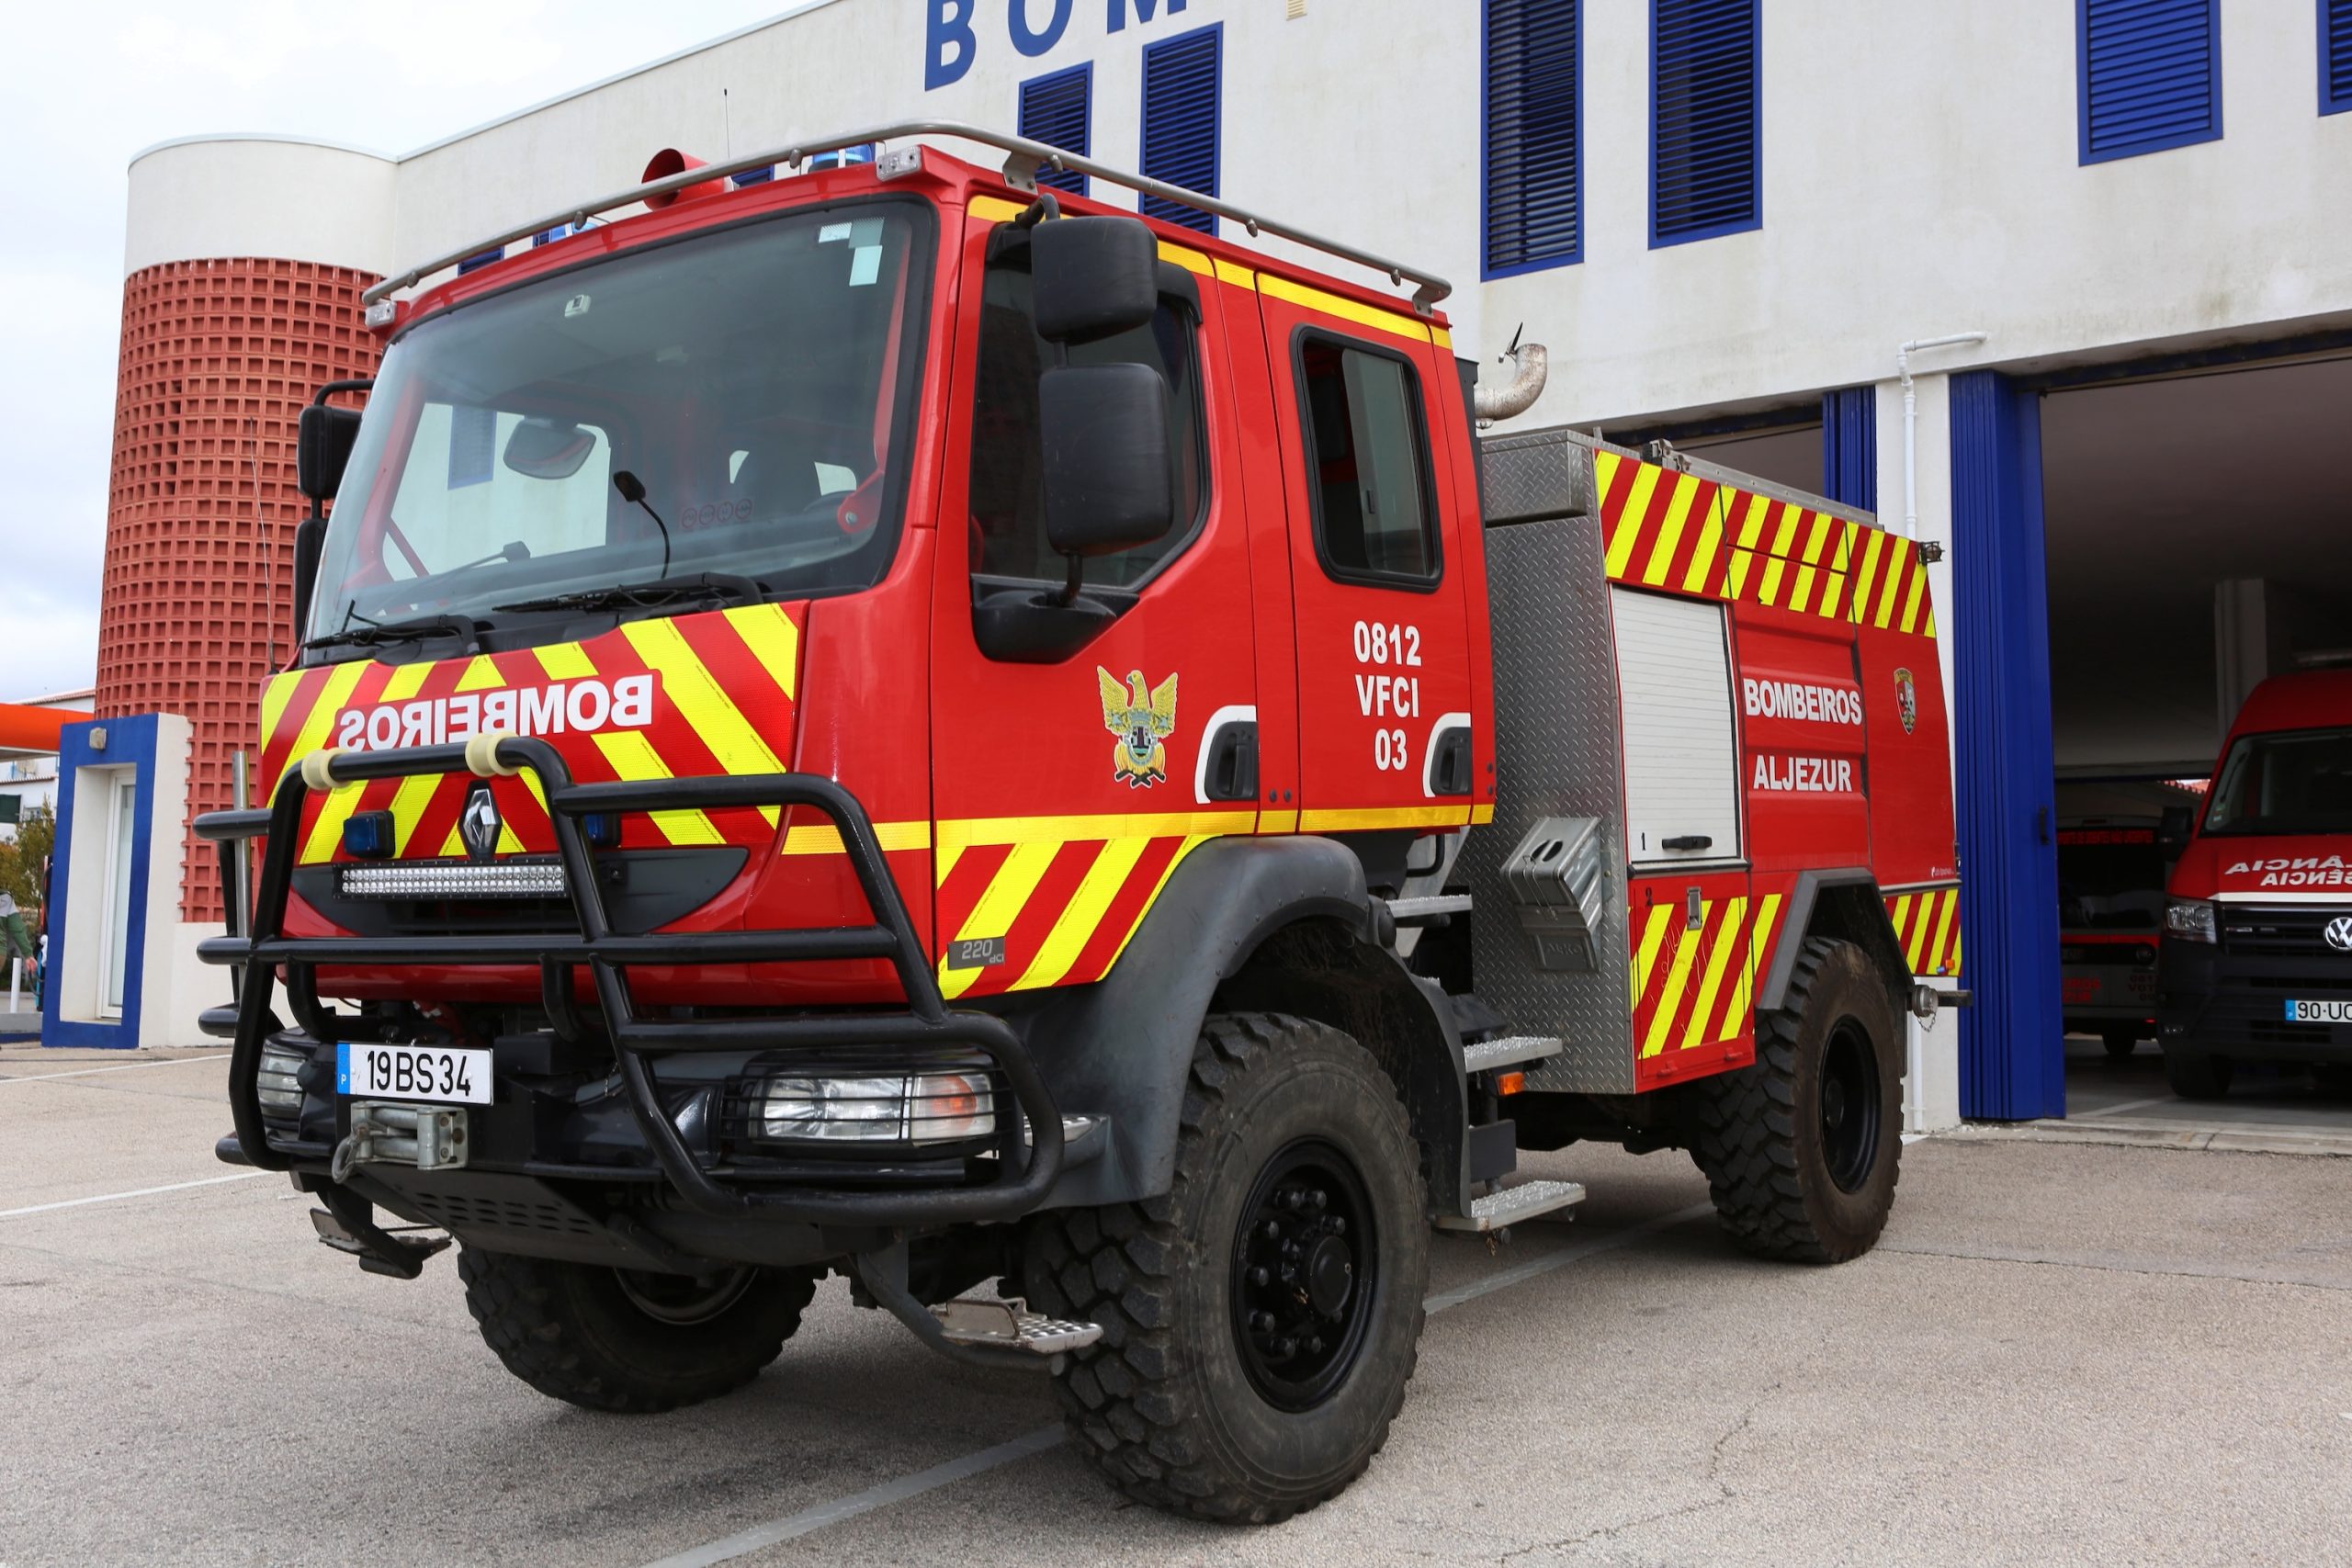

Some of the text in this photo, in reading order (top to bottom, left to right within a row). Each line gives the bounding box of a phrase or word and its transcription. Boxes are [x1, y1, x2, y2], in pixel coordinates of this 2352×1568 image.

[1353, 620, 1422, 666] 0812
[1355, 674, 1419, 718] VFCI
[1743, 678, 1862, 726] BOMBEIROS
[1374, 728, 1408, 771] 03
[1753, 755, 1852, 792] ALJEZUR
[962, 939, 993, 960] 220
